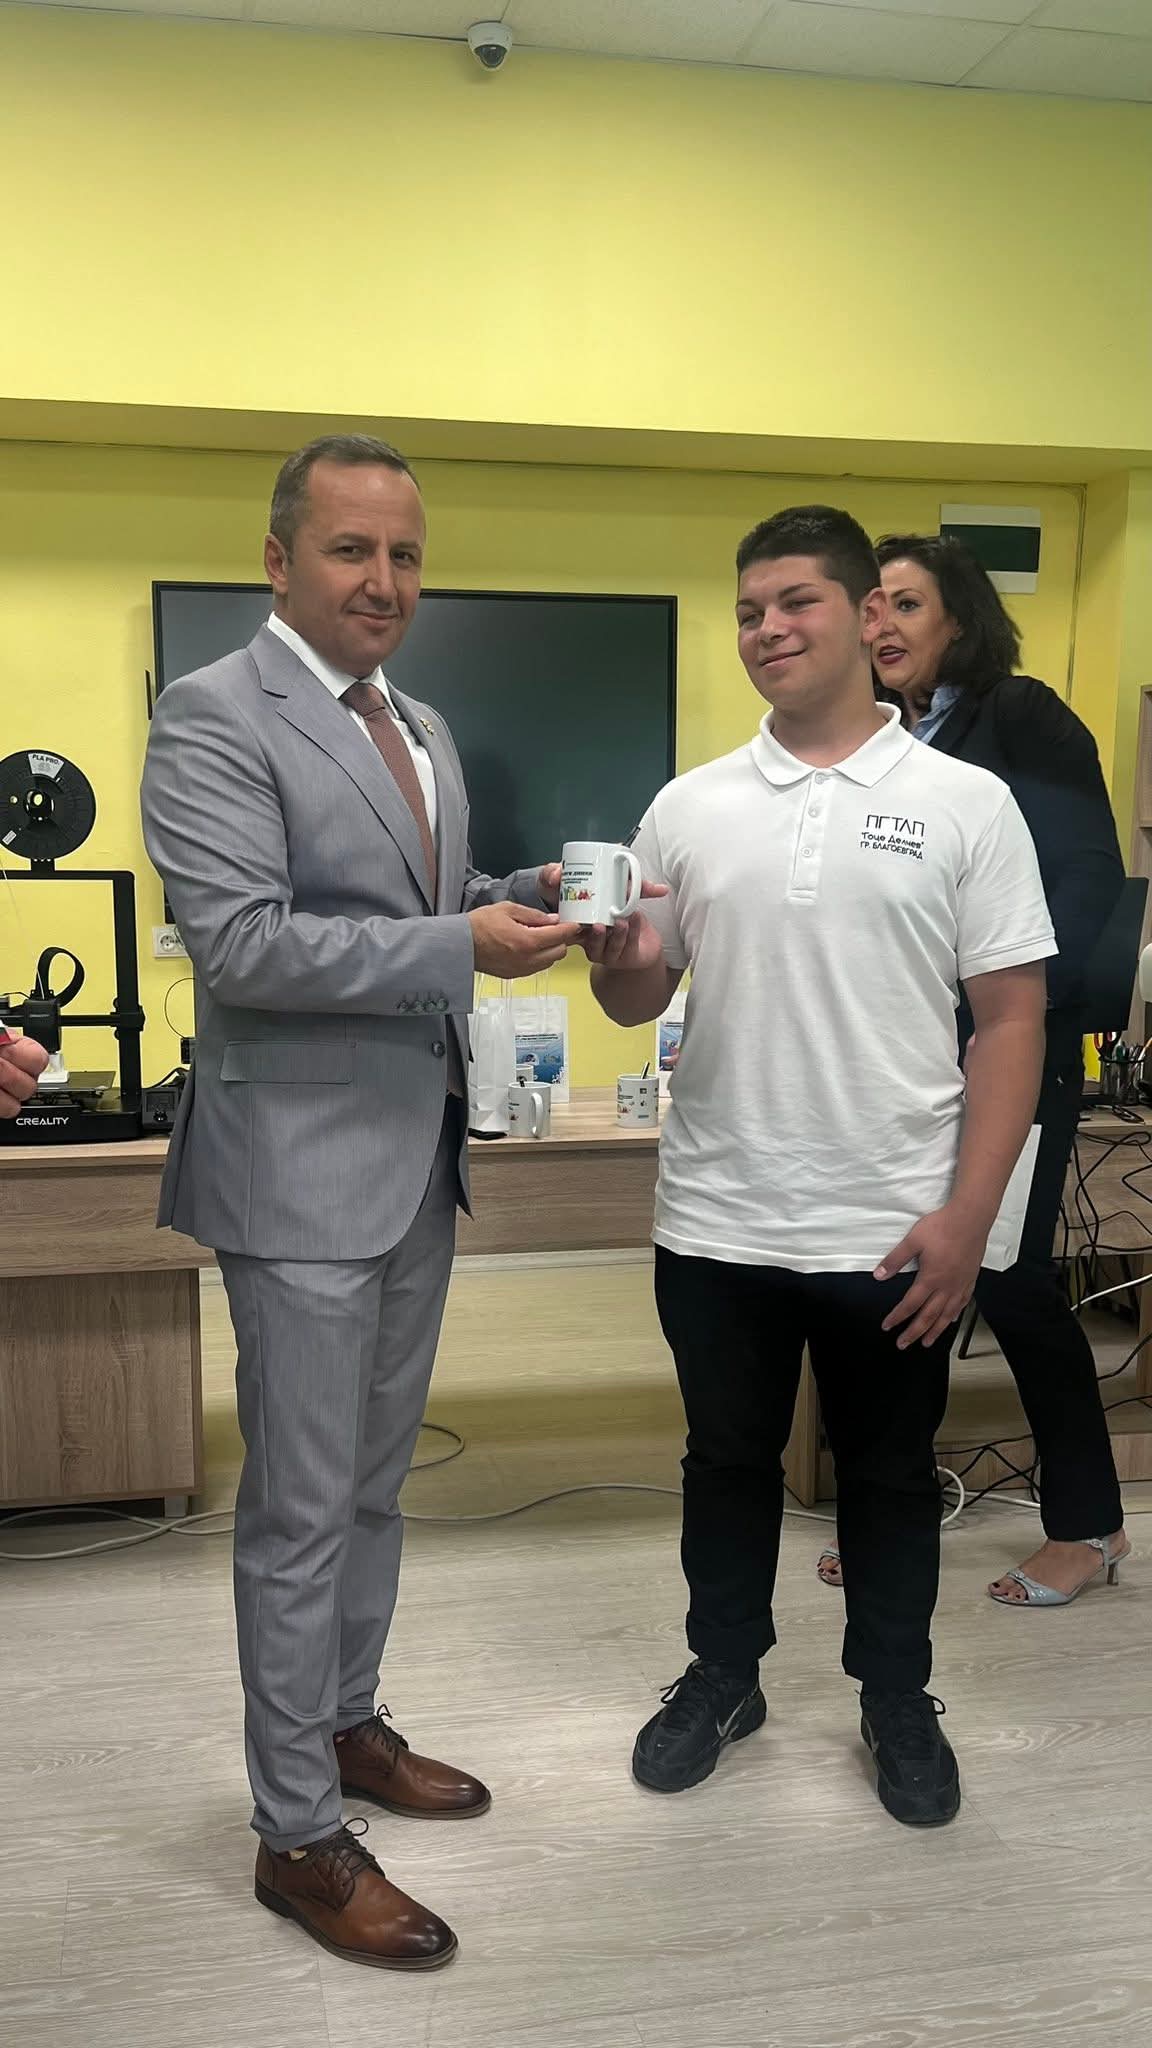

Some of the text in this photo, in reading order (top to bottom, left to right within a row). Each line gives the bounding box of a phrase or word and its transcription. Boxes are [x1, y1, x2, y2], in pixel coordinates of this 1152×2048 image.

[866, 814, 925, 837] ПГТЛП
[872, 842, 923, 860] БЛАГОЕВГРАД
[15, 1117, 69, 1126] CREALITY
